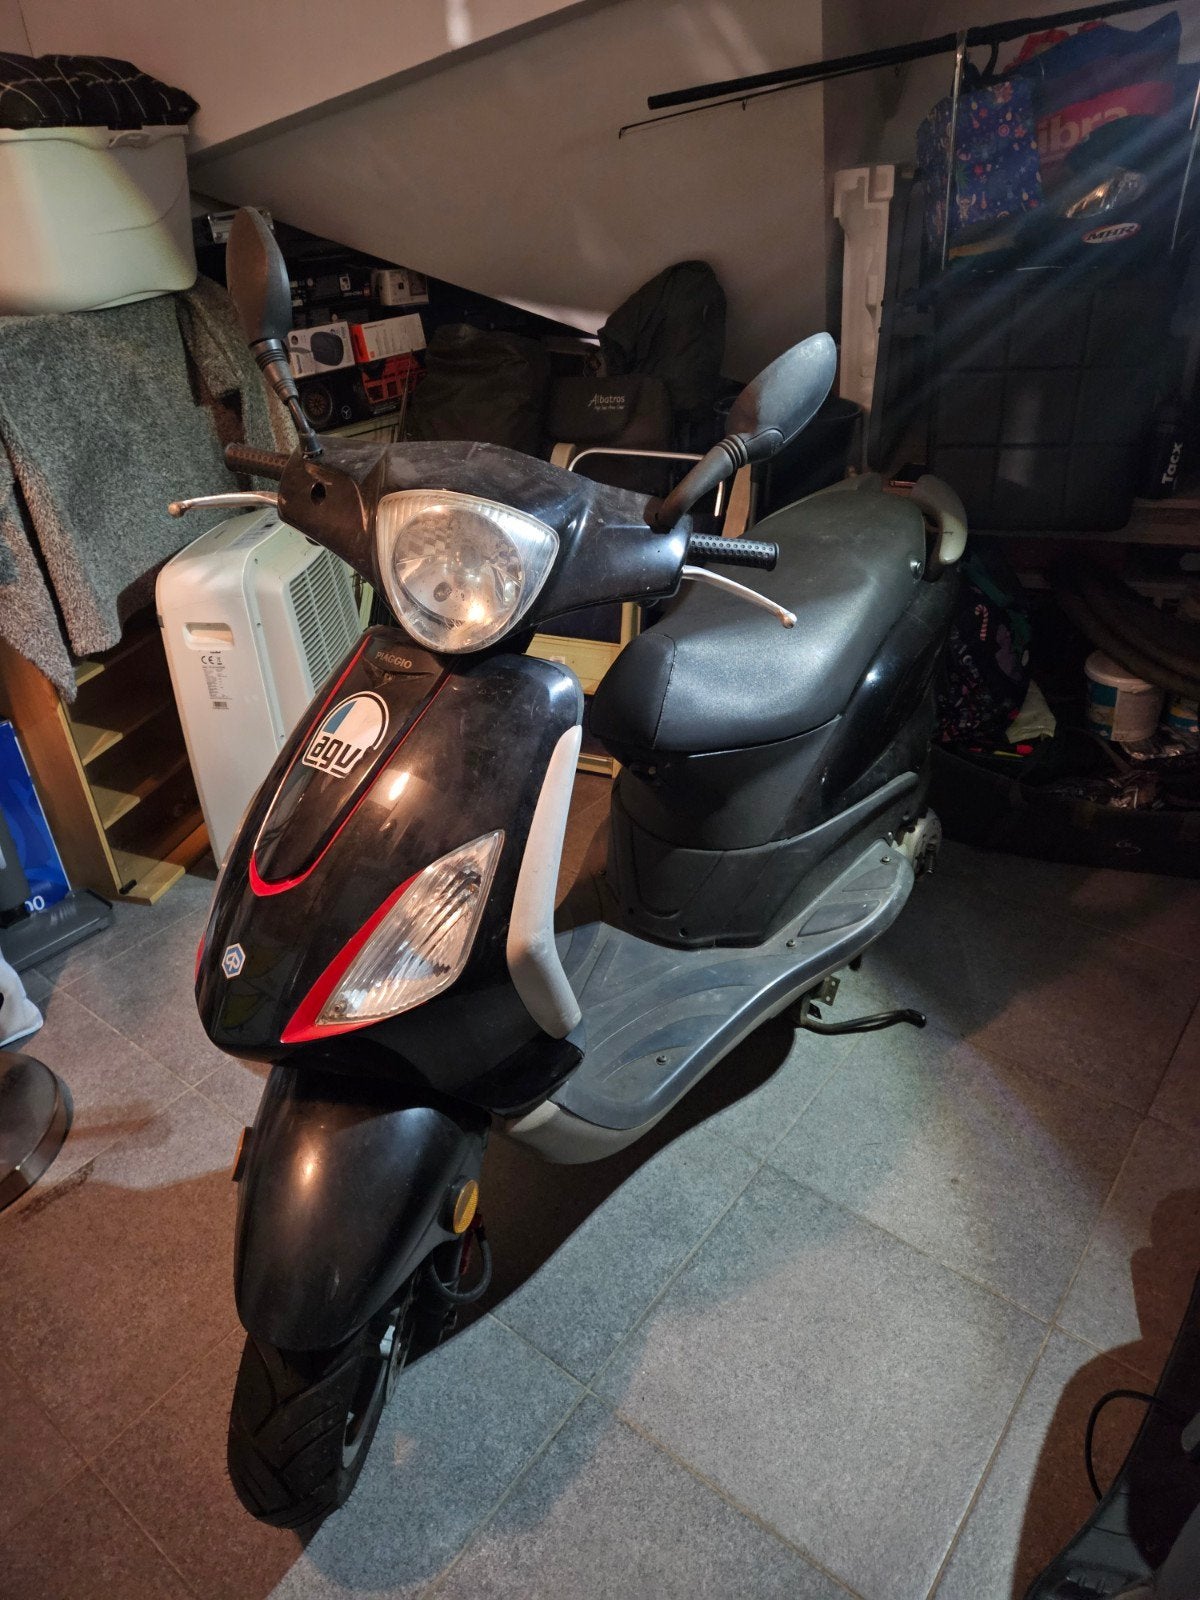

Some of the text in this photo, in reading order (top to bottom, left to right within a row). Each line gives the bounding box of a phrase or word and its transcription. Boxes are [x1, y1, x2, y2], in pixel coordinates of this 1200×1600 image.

[588, 393, 625, 407] Albatros
[1161, 442, 1183, 484] Tacx
[201, 655, 215, 665] CE
[375, 651, 412, 669] PIAGGIO
[310, 735, 362, 770] agv
